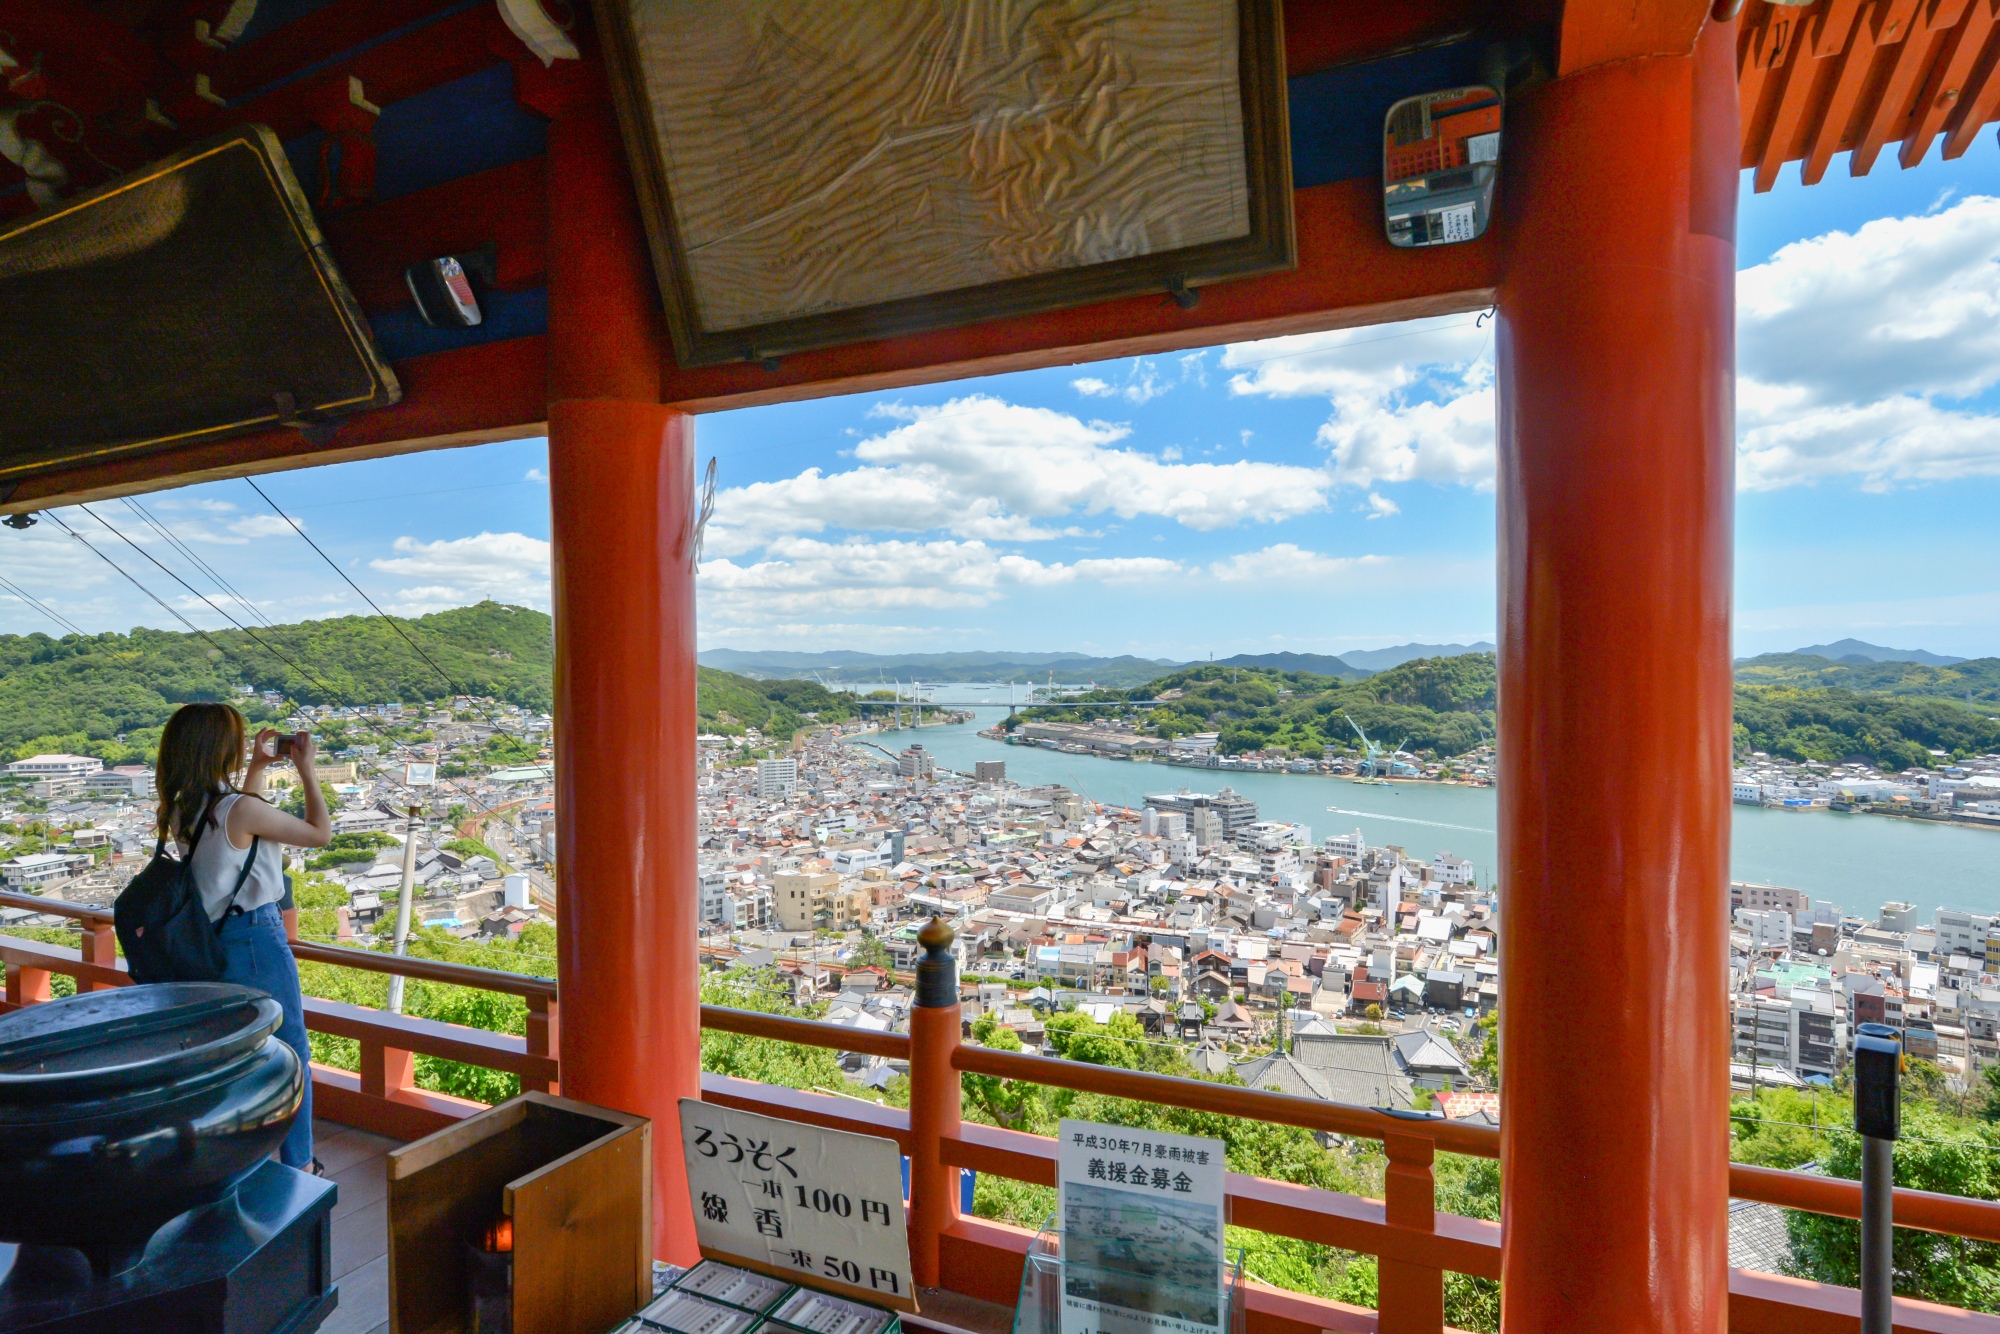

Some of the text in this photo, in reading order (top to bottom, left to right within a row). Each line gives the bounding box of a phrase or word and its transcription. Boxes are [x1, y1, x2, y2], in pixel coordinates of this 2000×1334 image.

[694, 1125, 798, 1178] ろうそく
[1072, 1133, 1210, 1166] 平成30年7月豪雨被害
[1087, 1157, 1193, 1193] 義援金募金
